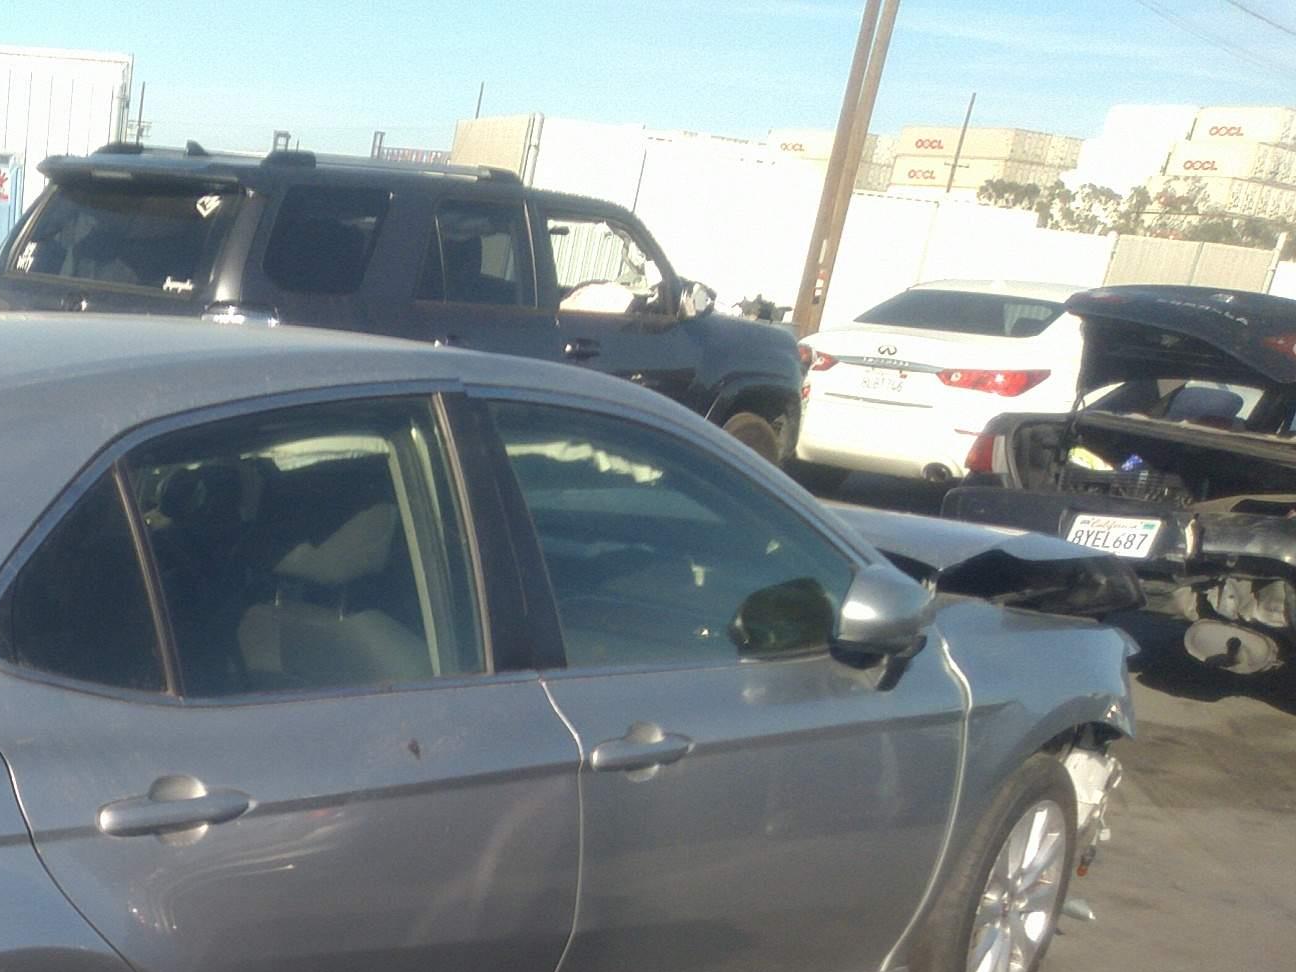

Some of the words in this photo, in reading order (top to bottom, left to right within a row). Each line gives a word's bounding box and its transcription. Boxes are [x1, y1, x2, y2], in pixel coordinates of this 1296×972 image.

[1208, 126, 1244, 137] OOCL
[915, 138, 944, 150] OOCL
[1183, 160, 1218, 171] OOCL
[908, 169, 936, 180] OOCL
[1072, 529, 1149, 550] 8YEL687
